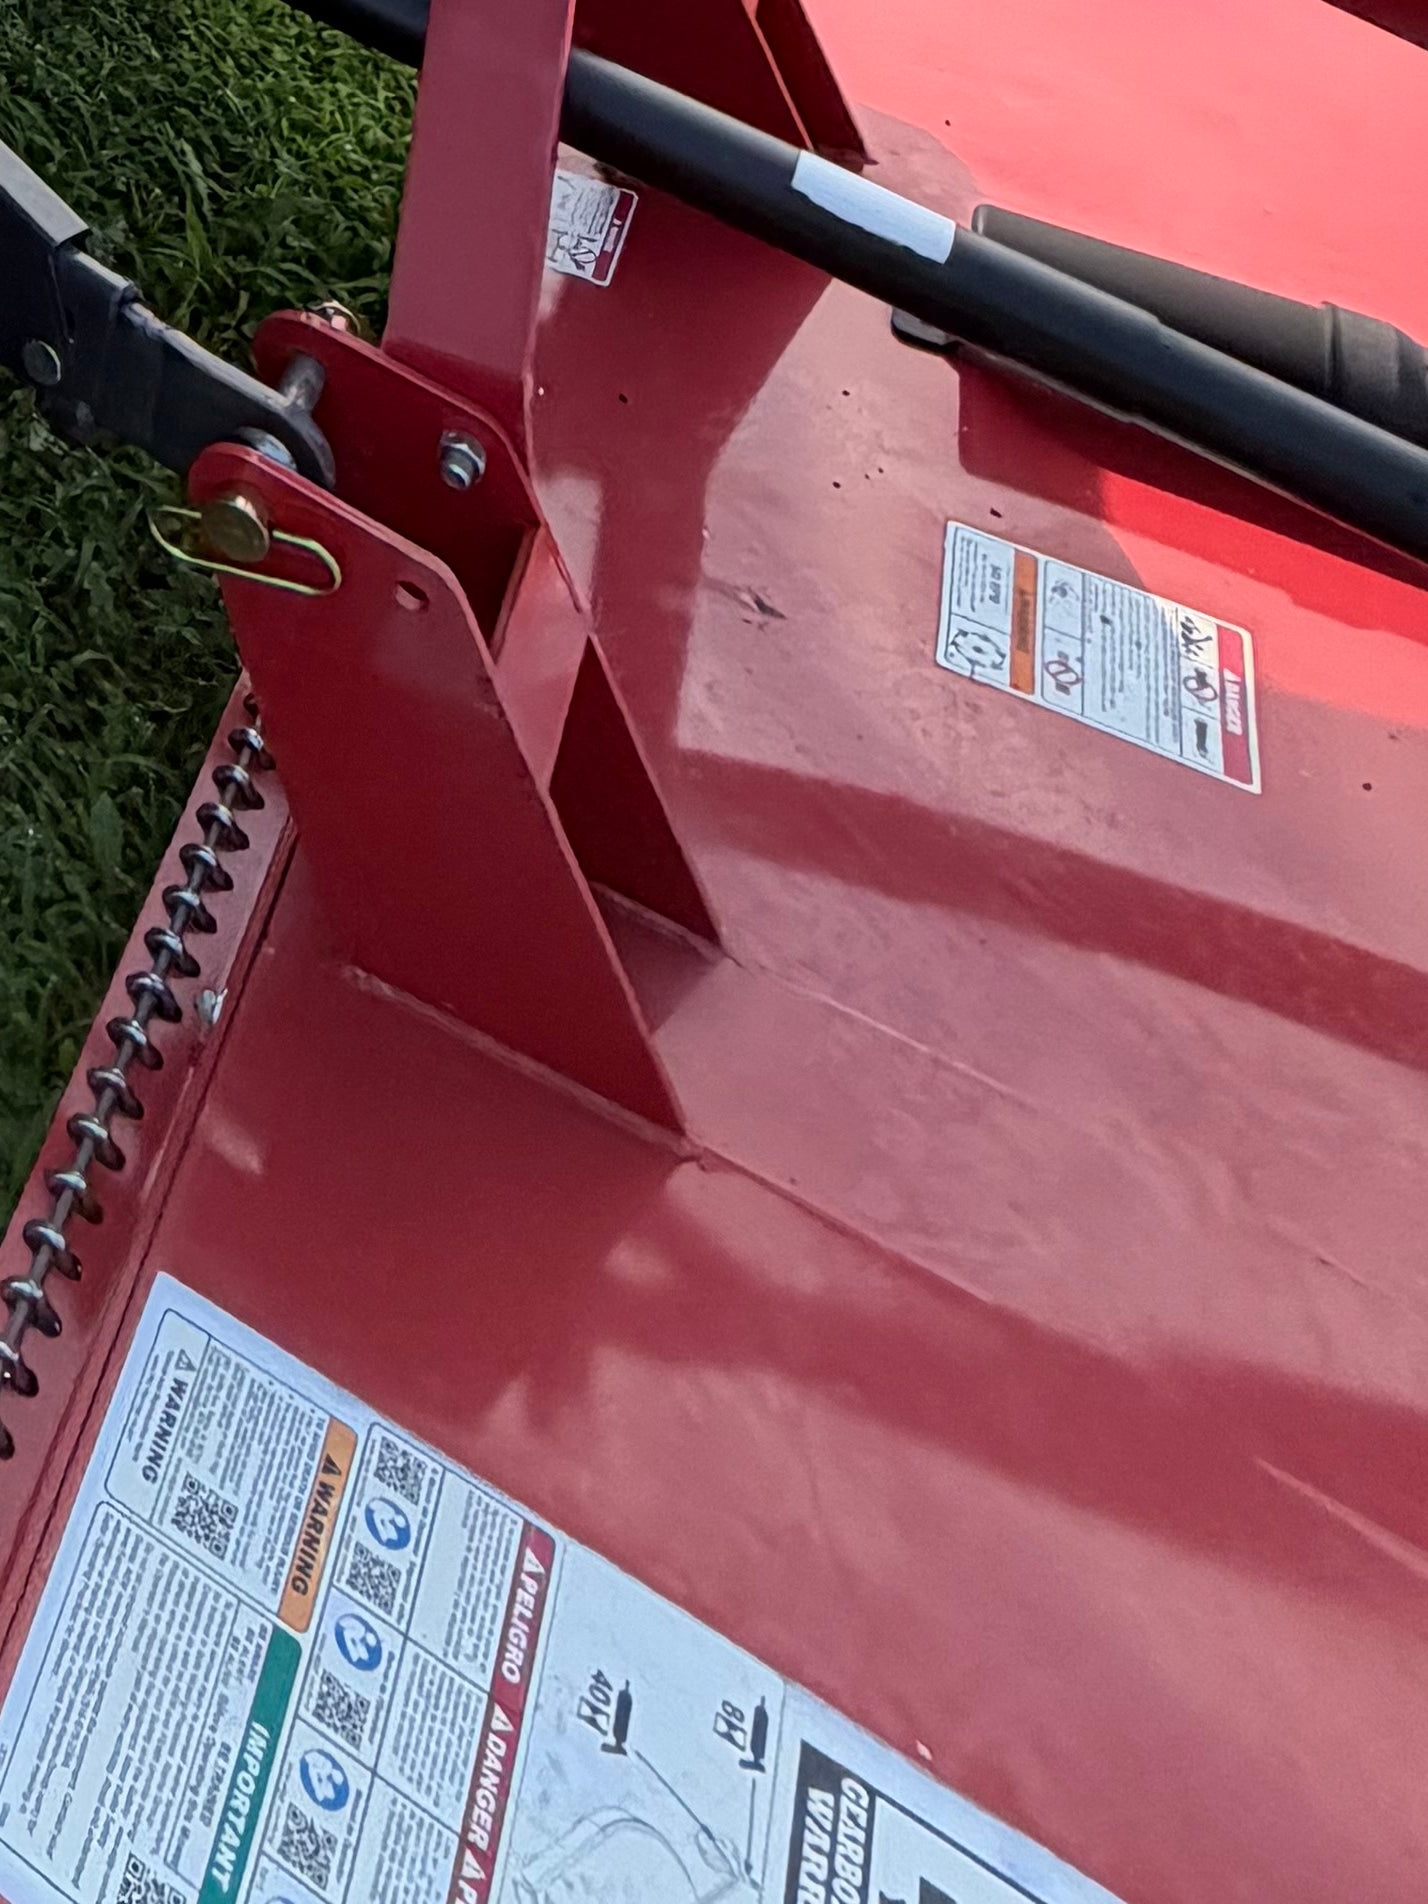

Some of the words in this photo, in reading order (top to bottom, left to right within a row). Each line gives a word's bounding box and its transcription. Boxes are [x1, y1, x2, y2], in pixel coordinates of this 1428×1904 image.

[139, 1375, 187, 1485] WARNING
[288, 1479, 335, 1595] WARNING
[499, 1572, 539, 1684] PELIGRO
[587, 1667, 616, 1707] 40
[720, 1698, 745, 1723] 8
[209, 1720, 271, 1892] IMPORTANT
[466, 1731, 507, 1851] DANGER
[834, 1778, 869, 1904] GEARBO
